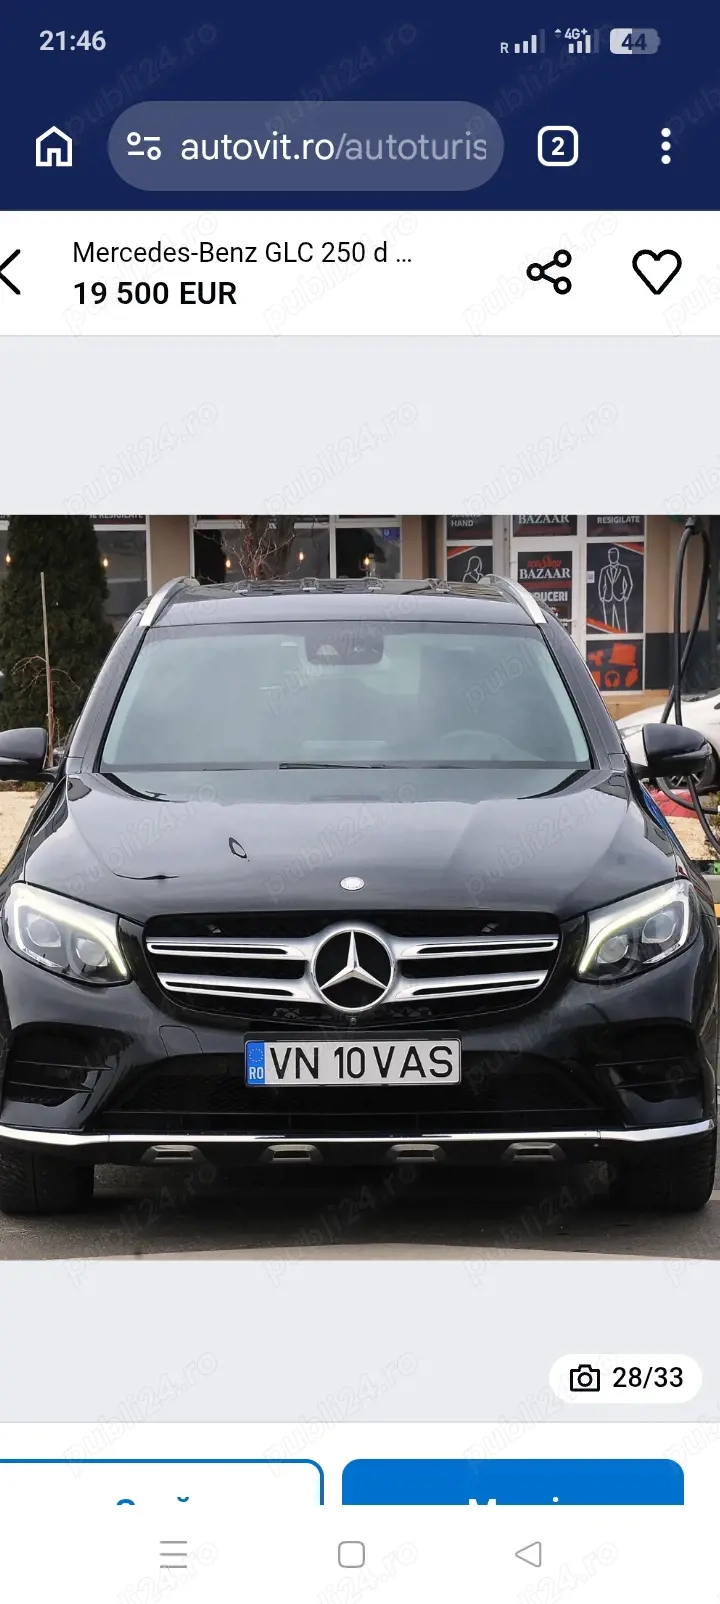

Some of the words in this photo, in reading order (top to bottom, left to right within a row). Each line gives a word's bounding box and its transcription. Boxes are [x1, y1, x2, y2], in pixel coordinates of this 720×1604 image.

[40, 30, 106, 51] 21:46
[501, 42, 509, 53] R
[621, 33, 647, 51] 44
[550, 137, 565, 156] 2
[74, 241, 257, 263] Mercedes-Benz
[266, 242, 313, 263] GLC
[322, 242, 365, 263] 250
[374, 241, 388, 263] d
[74, 282, 107, 304] 19
[117, 282, 168, 304] 500
[181, 282, 237, 304] EUR
[451, 519, 474, 527] HAND
[597, 516, 641, 524] RESIGILATE
[519, 568, 571, 580] BAZAAR
[270, 1047, 319, 1080] VN
[334, 1046, 366, 1079] 10
[373, 1045, 453, 1079] VAS
[249, 1067, 264, 1079] RO
[613, 1367, 684, 1390] 28/33
